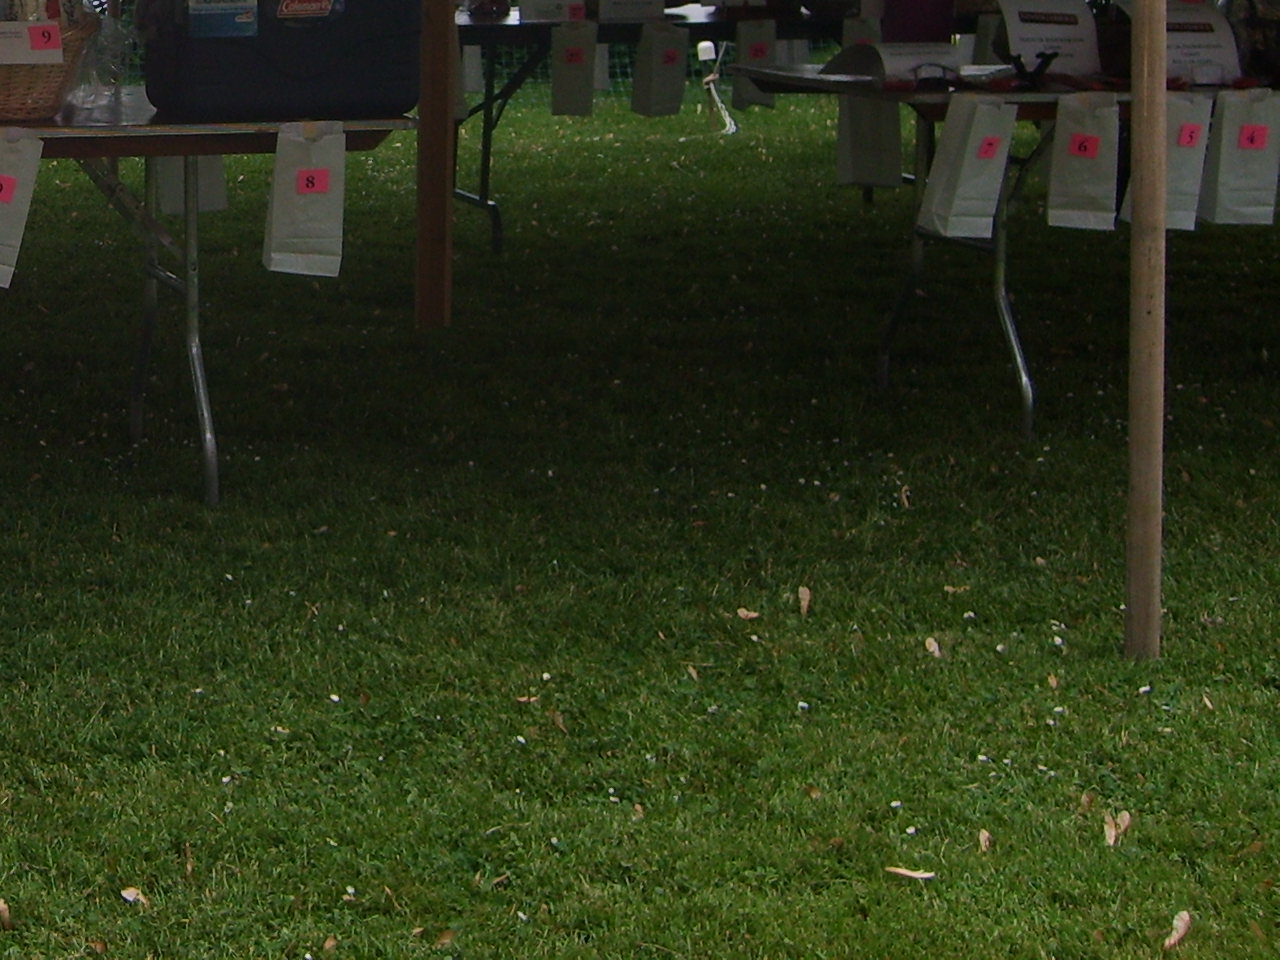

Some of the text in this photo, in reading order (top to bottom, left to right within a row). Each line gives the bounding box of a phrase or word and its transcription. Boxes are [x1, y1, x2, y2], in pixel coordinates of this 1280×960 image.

[41, 31, 51, 44] 9
[1186, 130, 1195, 144] 5
[1245, 130, 1256, 145] 4
[1078, 138, 1088, 152] 6
[305, 175, 315, 189] 8
